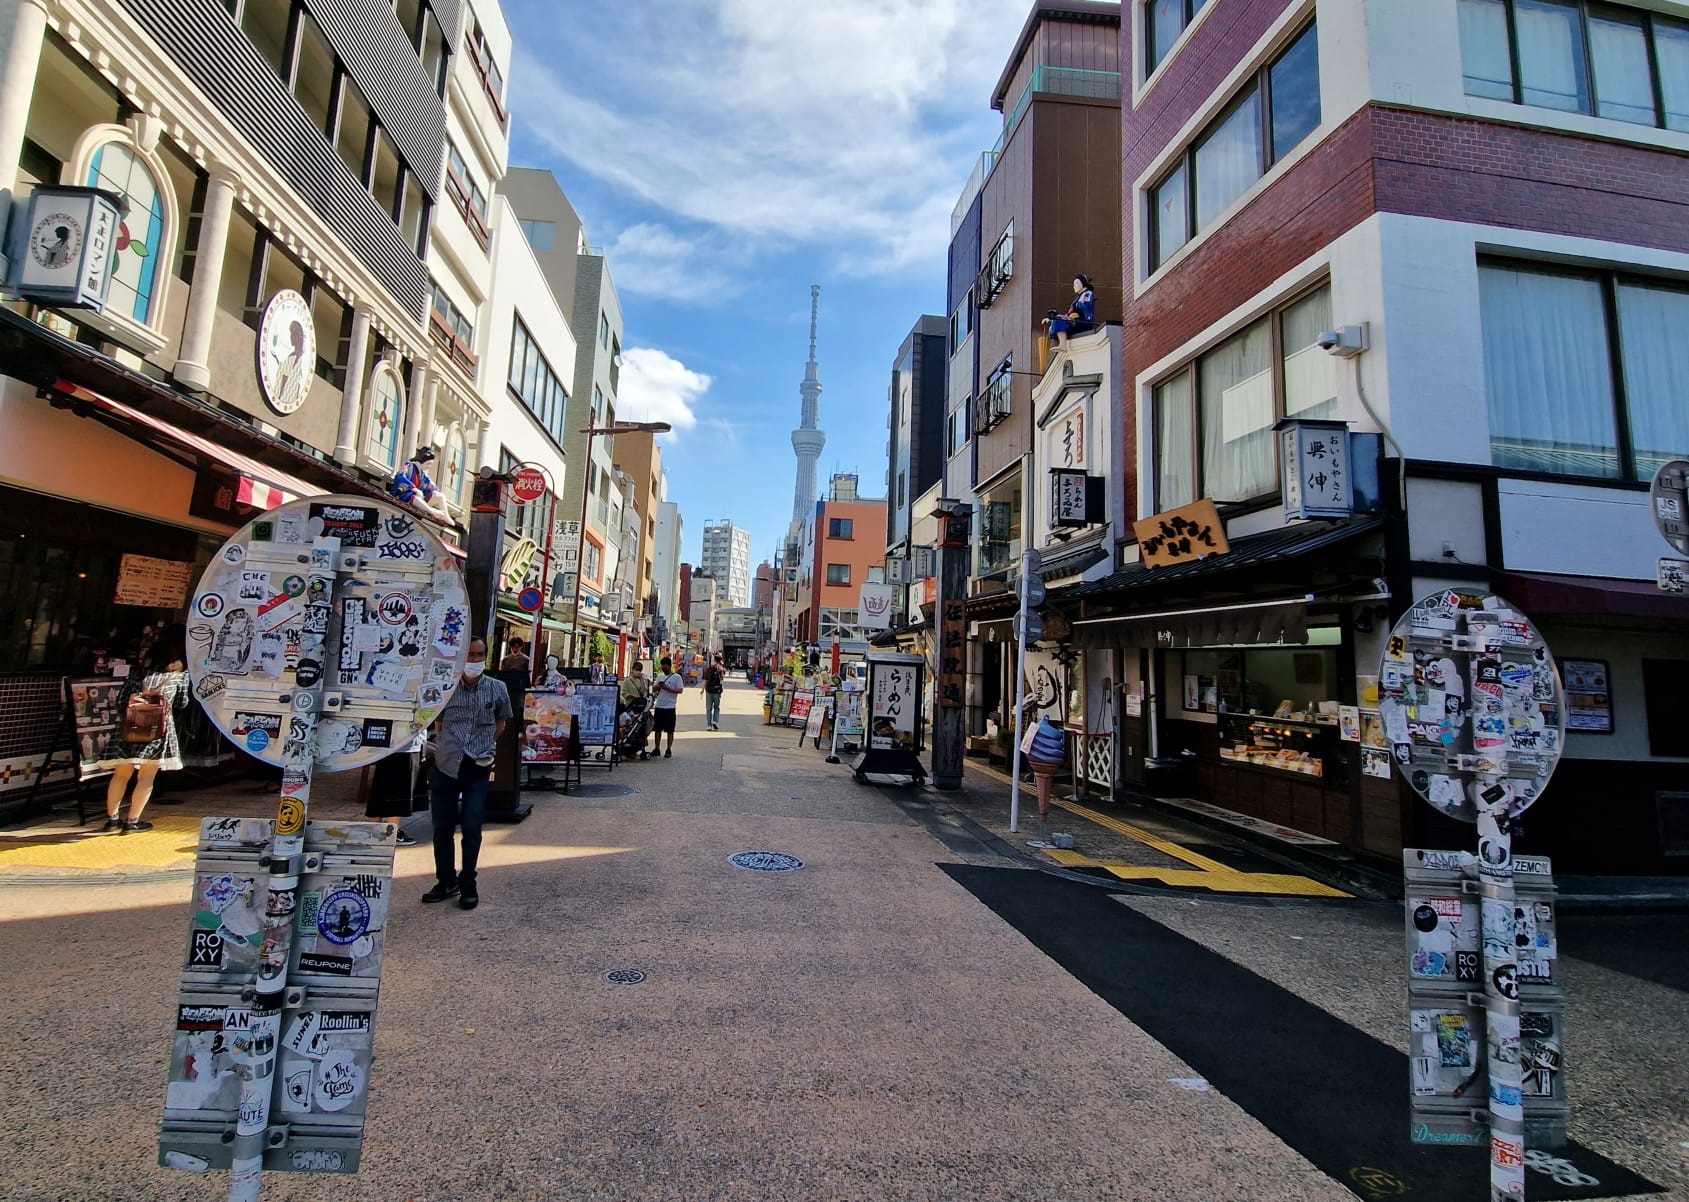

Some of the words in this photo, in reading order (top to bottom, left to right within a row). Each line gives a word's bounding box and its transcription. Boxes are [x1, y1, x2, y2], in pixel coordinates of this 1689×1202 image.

[1330, 435, 1342, 502] おいもやさん
[515, 478, 543, 491] 消火栓
[555, 520, 580, 535] 浅草
[887, 668, 901, 715] らーめん
[196, 934, 220, 947] RO
[194, 948, 219, 962] XY
[1458, 954, 1478, 966] RO
[1460, 967, 1479, 978] XY
[321, 1014, 369, 1030] Roollin's
